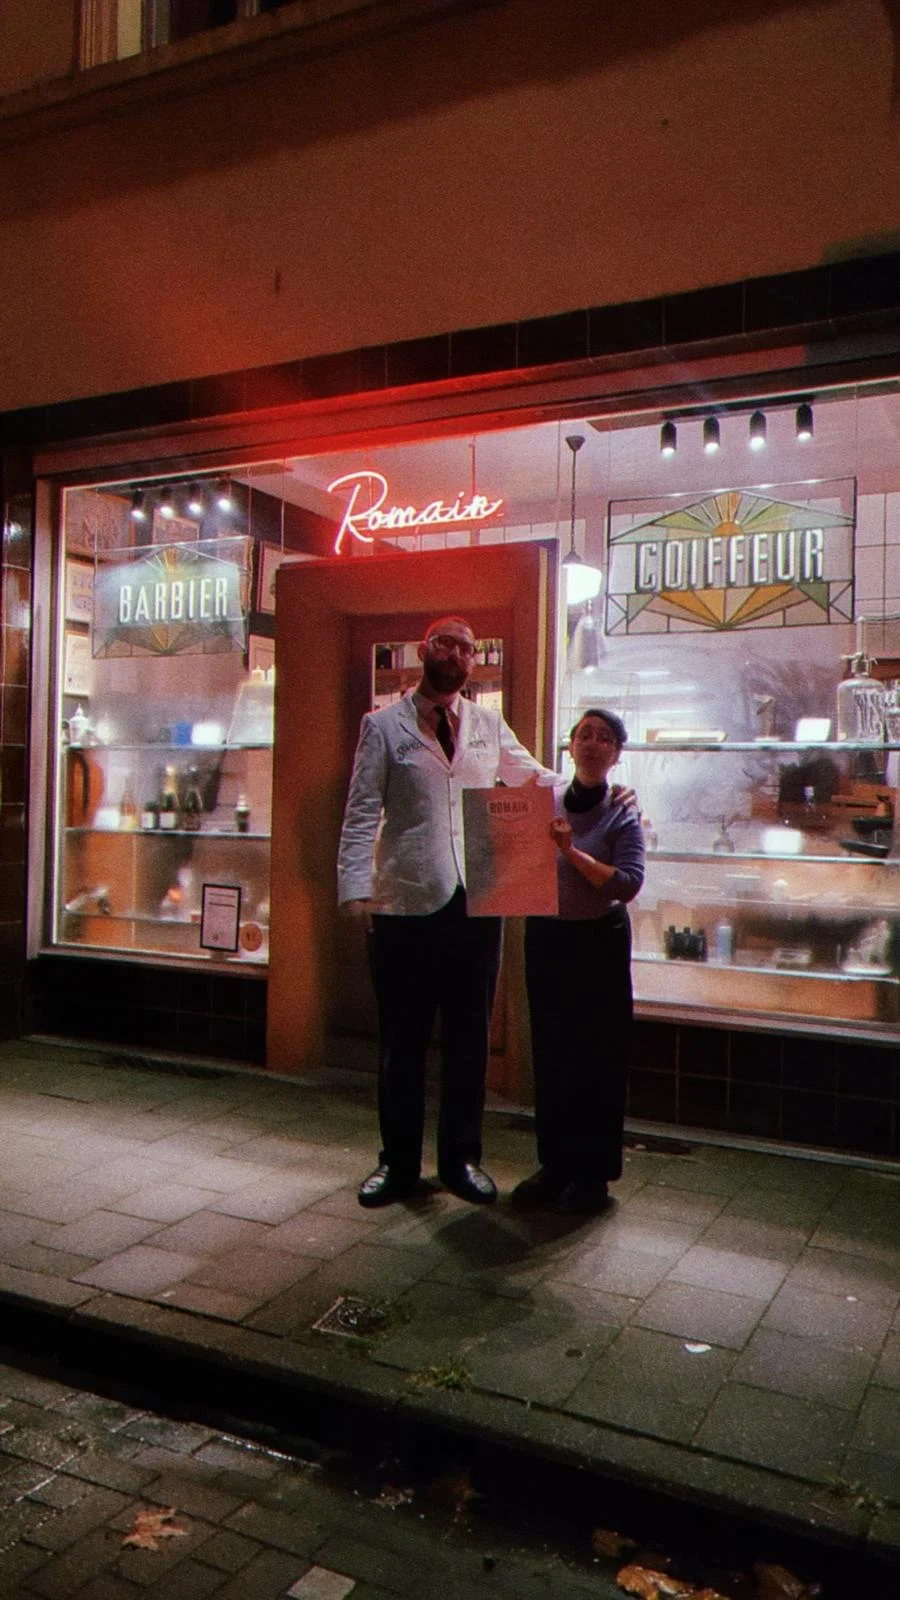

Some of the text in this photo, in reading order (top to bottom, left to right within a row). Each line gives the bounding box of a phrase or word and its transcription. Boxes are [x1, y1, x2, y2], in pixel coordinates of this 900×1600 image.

[327, 470, 503, 555] Romain
[637, 528, 824, 590] COIFFEUR
[118, 577, 228, 624] BARBIER
